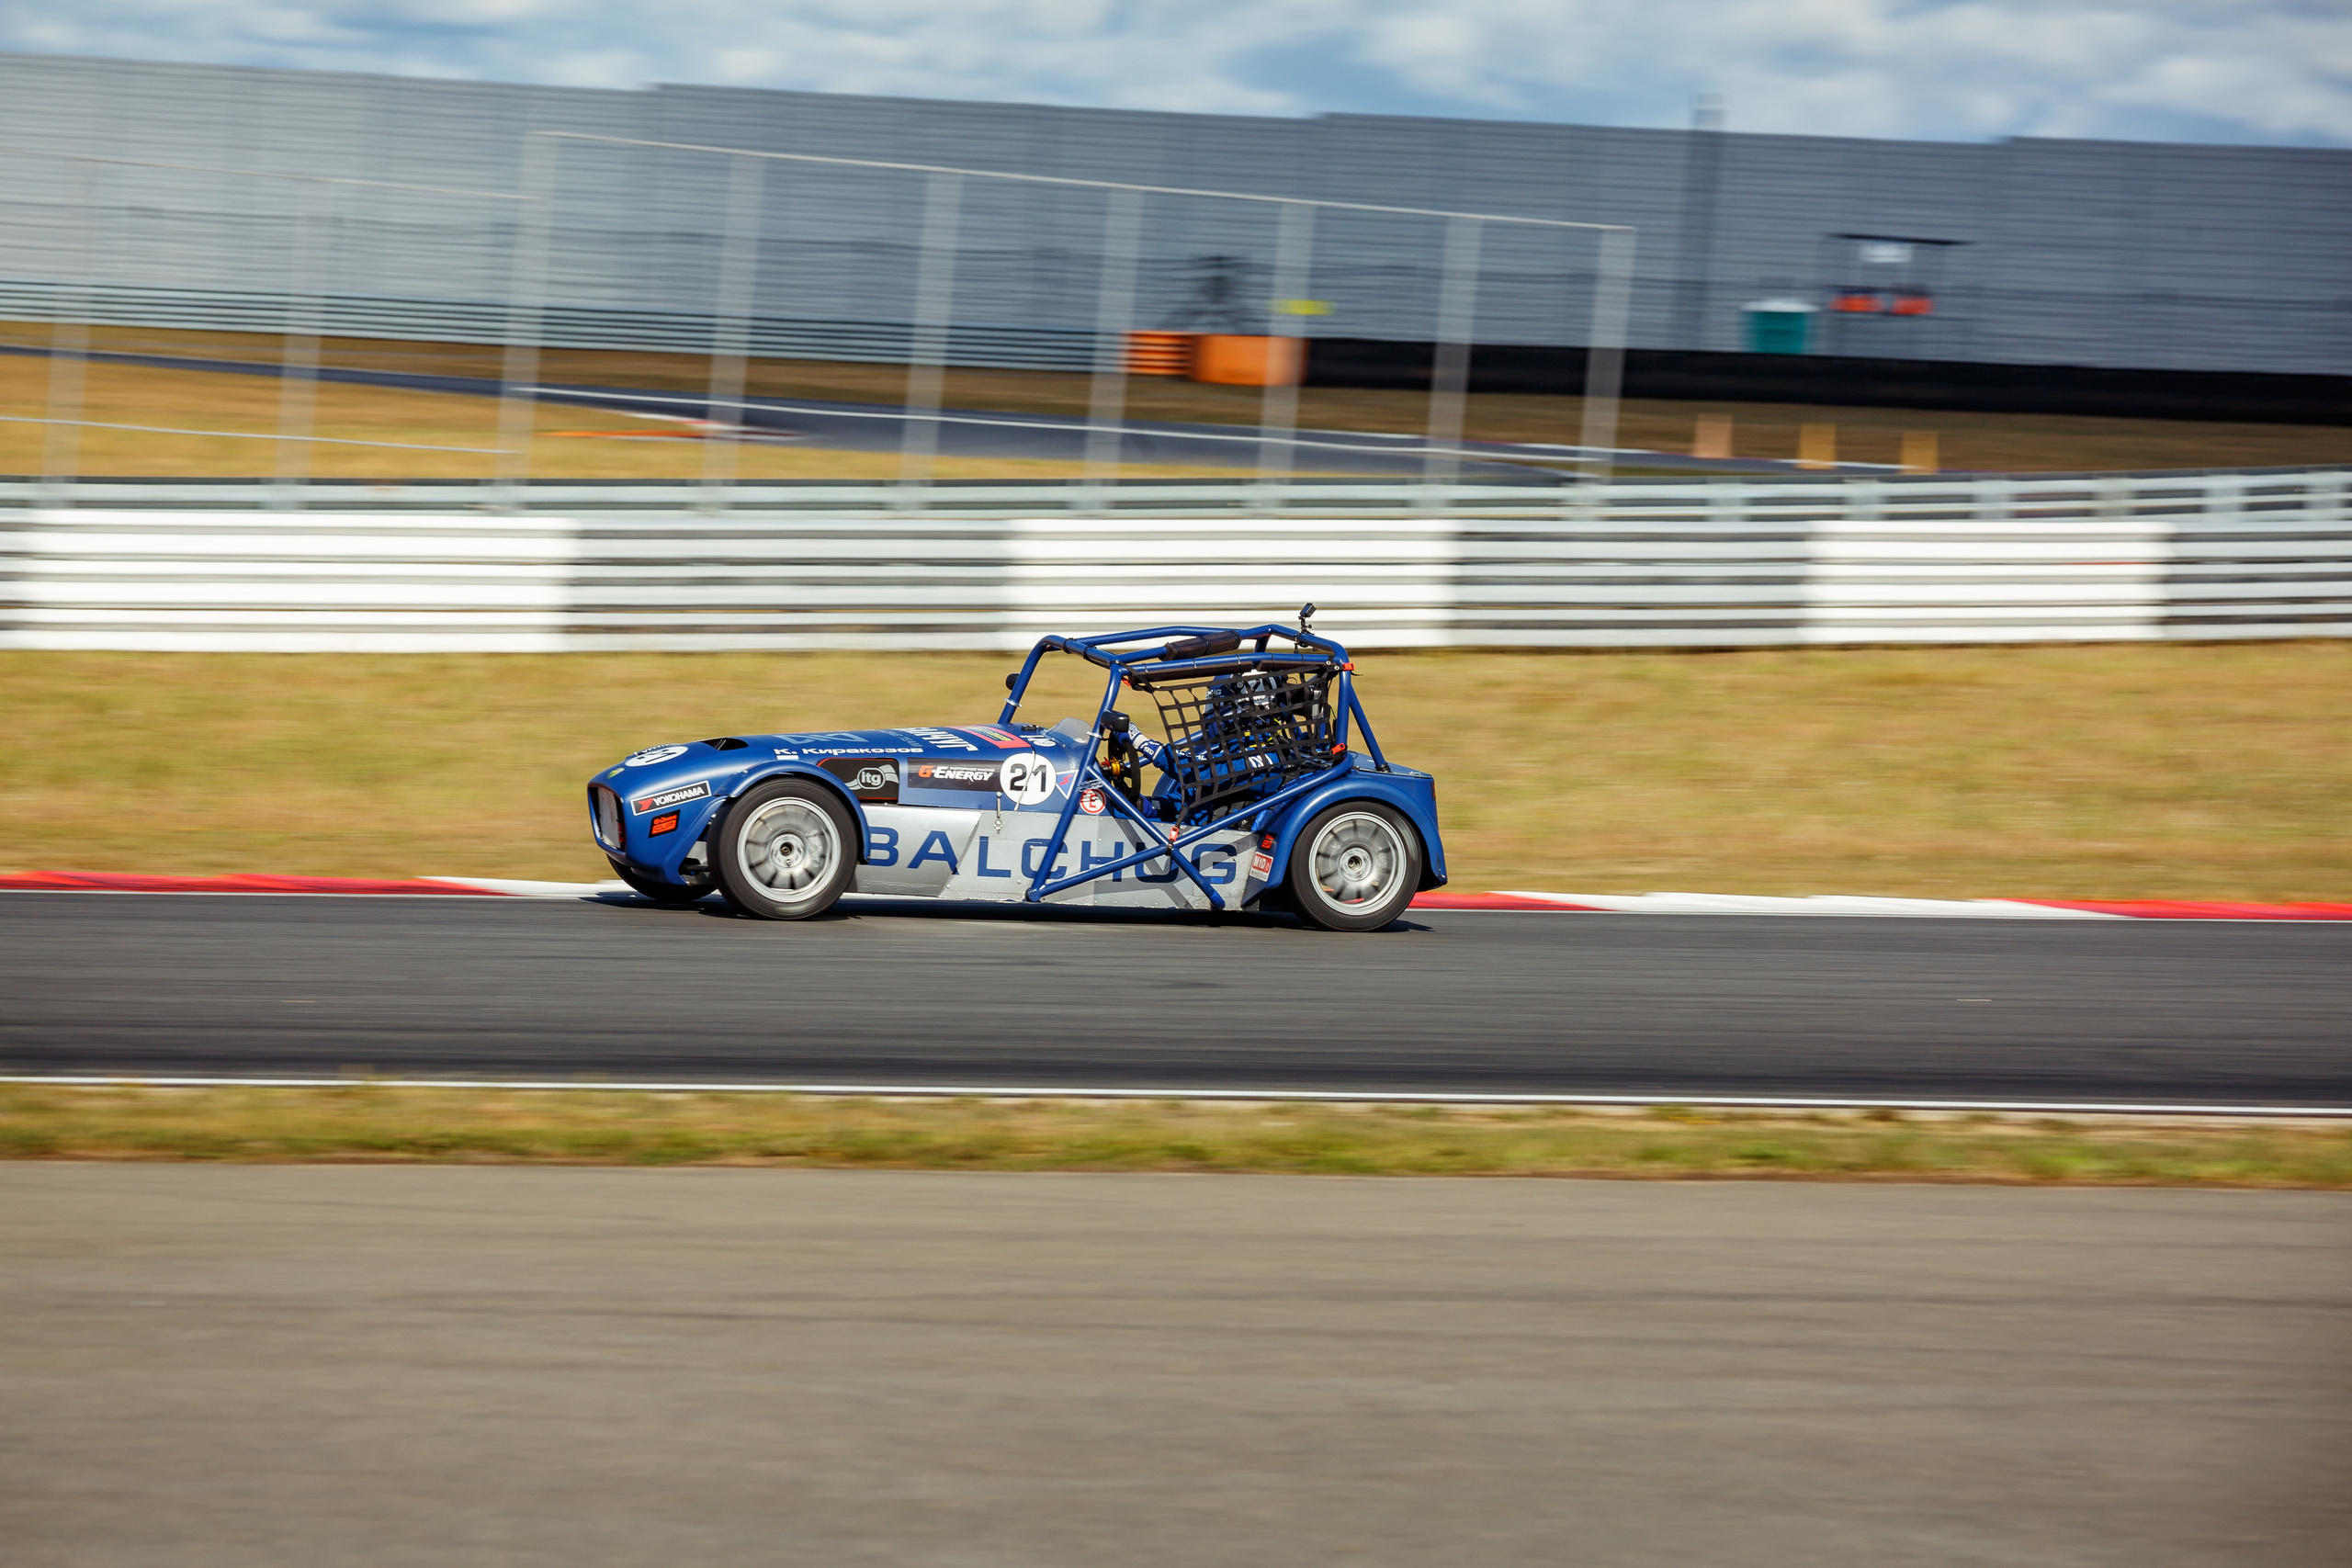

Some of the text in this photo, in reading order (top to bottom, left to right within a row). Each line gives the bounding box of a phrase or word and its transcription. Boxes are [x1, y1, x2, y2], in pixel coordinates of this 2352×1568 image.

[802, 747, 924, 756] Киракозов
[861, 771, 882, 786] itg
[1010, 762, 1047, 793] 21
[652, 786, 705, 807] YOKOHAMA
[868, 826, 1238, 885] BALCHUG
